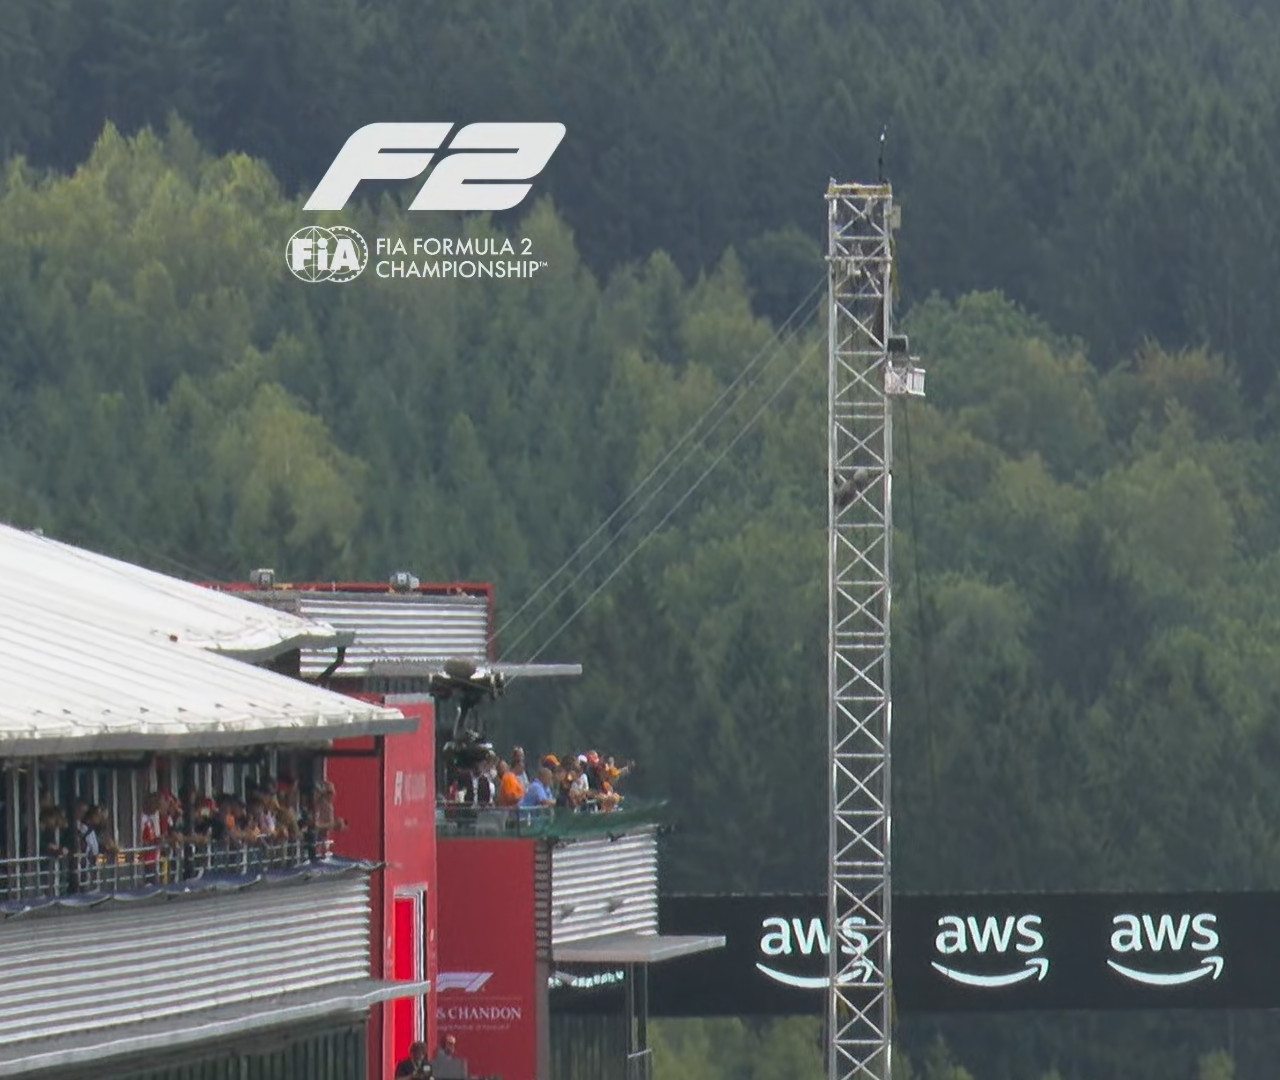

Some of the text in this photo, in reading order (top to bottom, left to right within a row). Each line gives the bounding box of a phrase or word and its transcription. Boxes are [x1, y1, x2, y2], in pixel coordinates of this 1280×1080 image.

[760, 916, 868, 955] aws
[935, 915, 1044, 953] aws
[1110, 913, 1219, 953] aws
[448, 1006, 521, 1020] CHANDON
